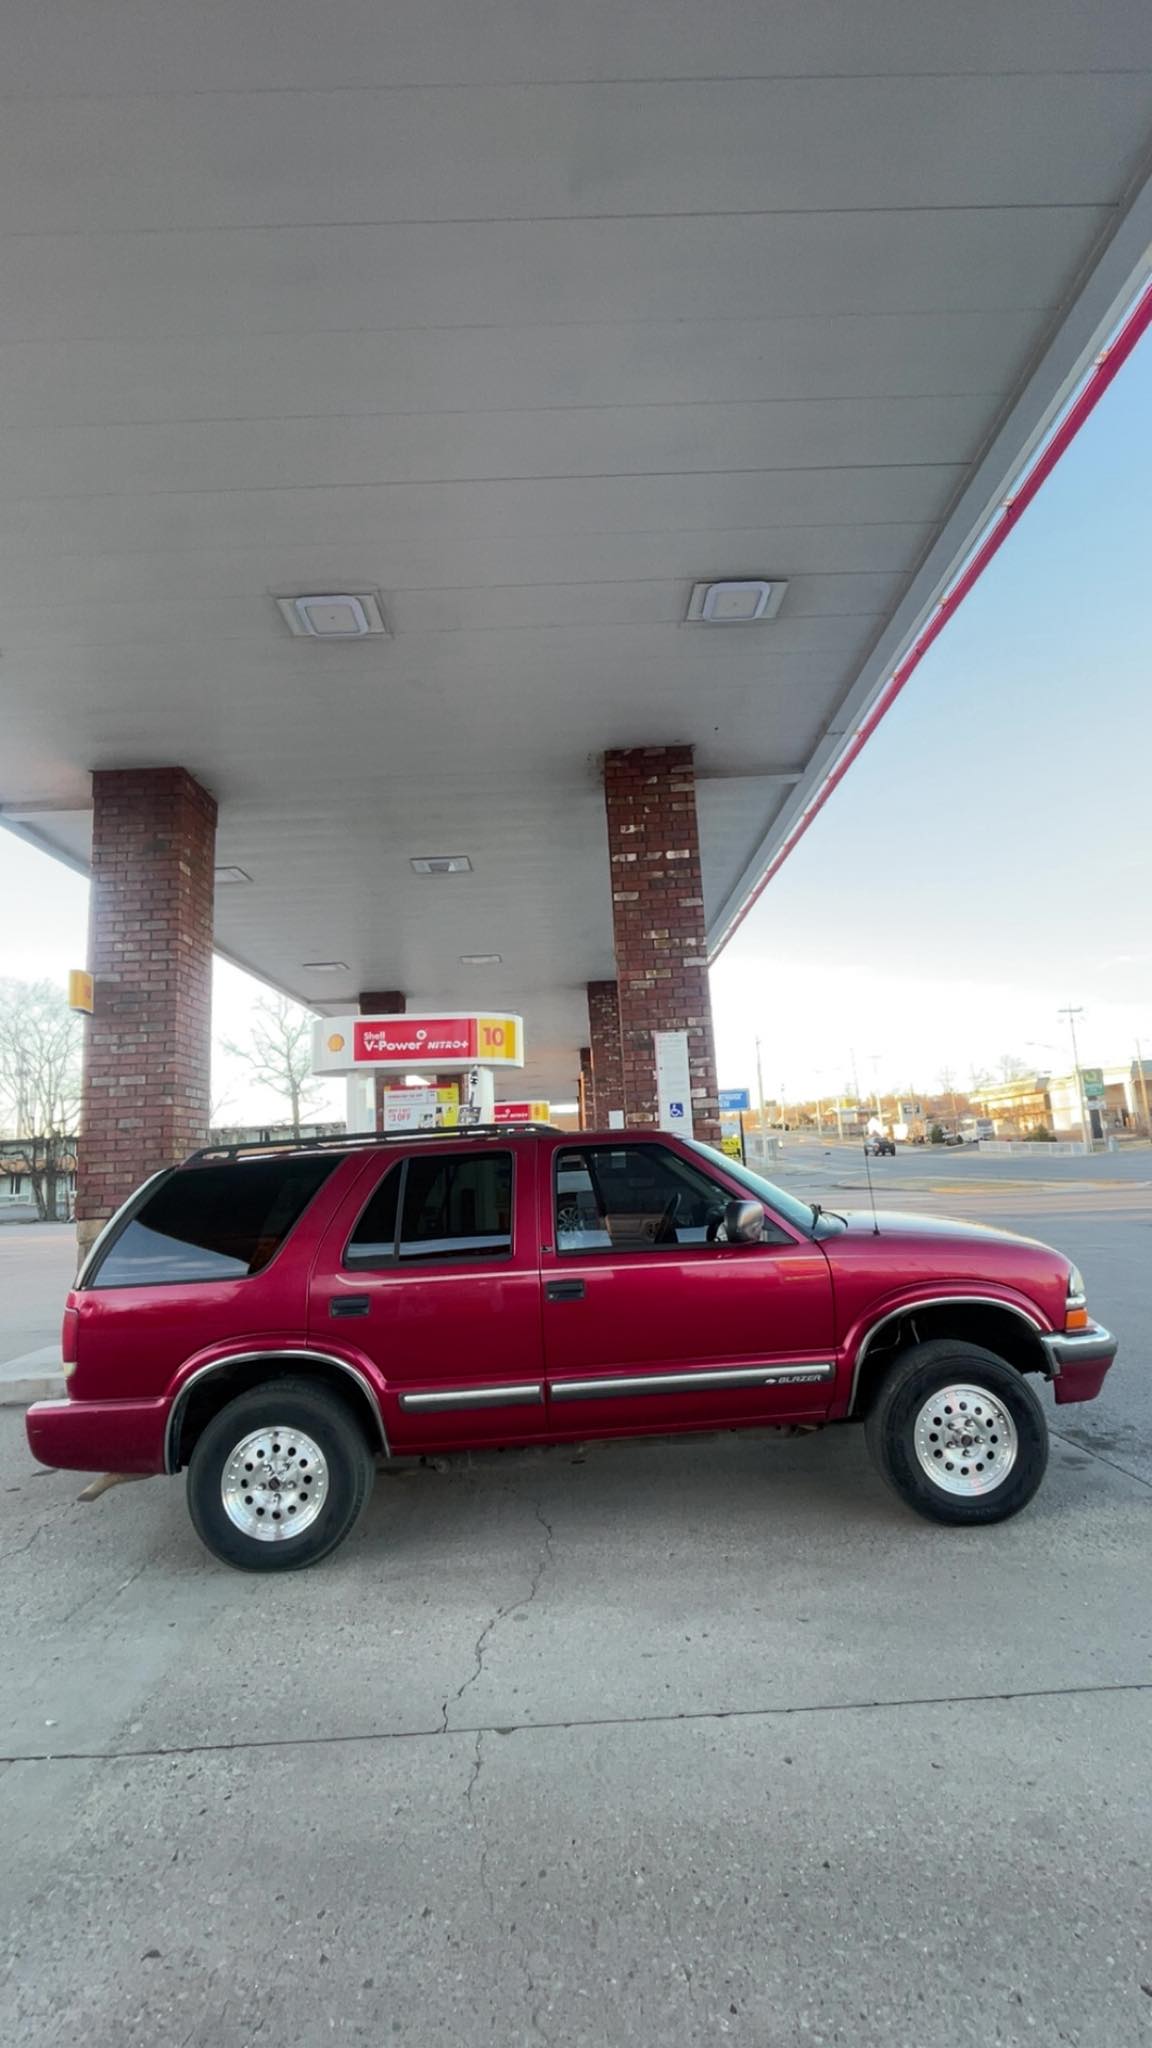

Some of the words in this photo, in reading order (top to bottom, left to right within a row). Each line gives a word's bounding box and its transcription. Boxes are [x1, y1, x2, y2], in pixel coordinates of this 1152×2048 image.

[363, 1031, 385, 1040] Shell
[482, 1027, 504, 1047] 10
[364, 1040, 423, 1052] V-Power
[778, 1374, 822, 1384] BLAZER
